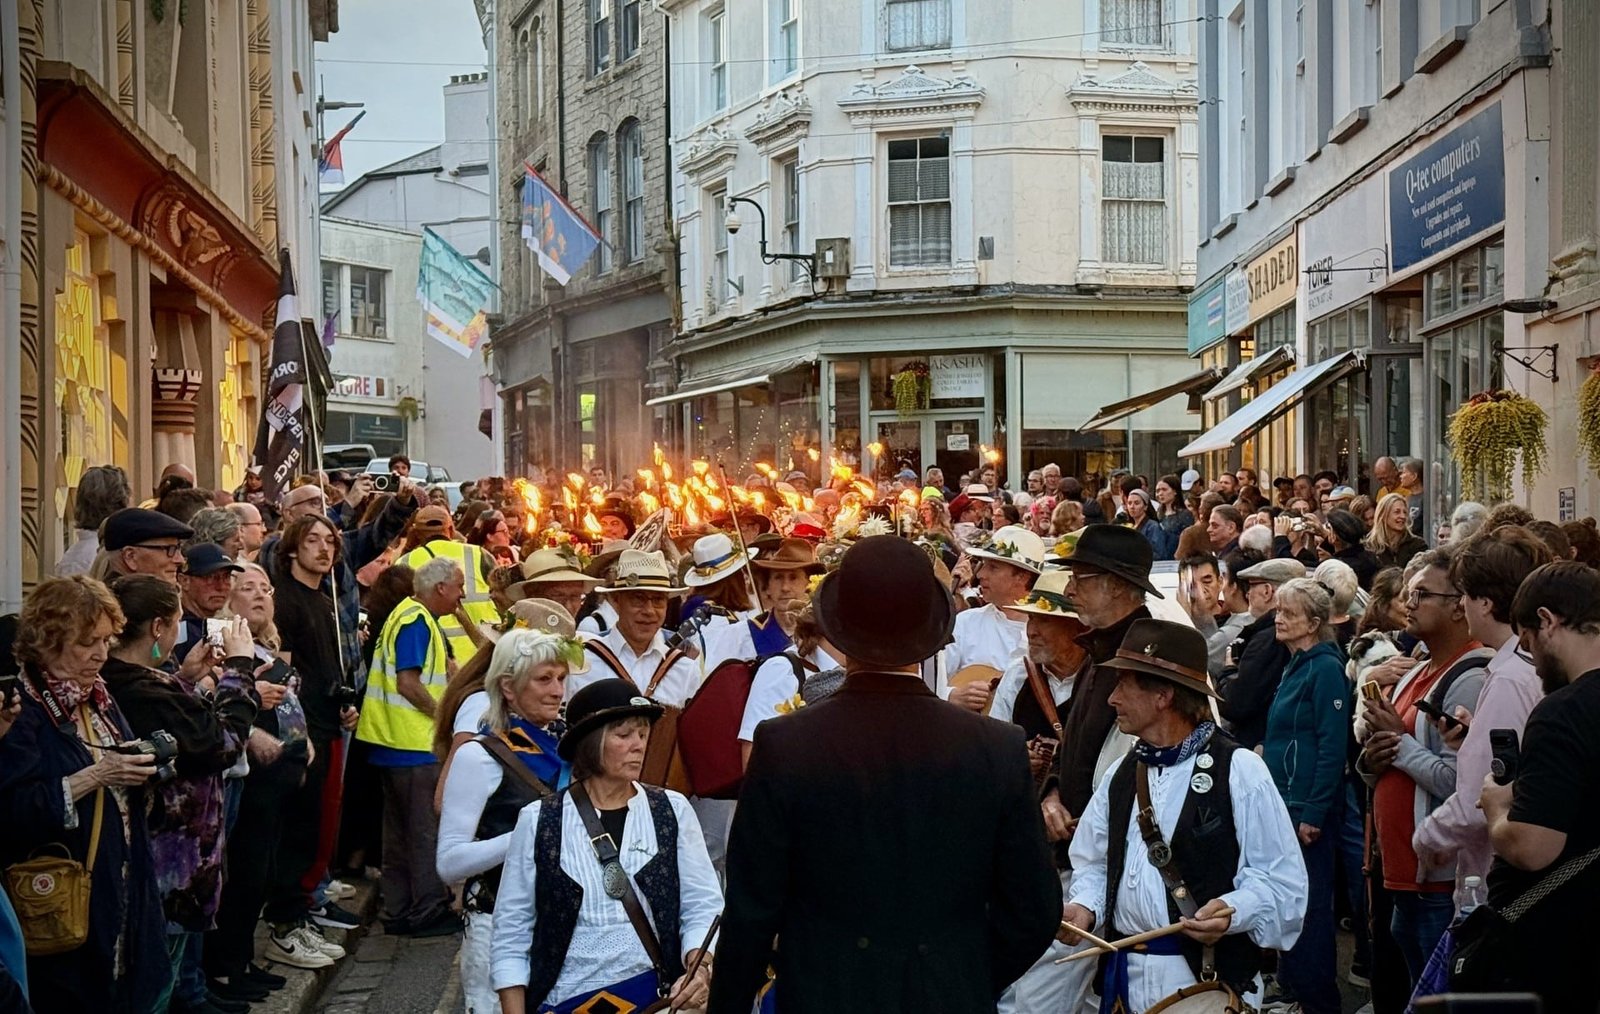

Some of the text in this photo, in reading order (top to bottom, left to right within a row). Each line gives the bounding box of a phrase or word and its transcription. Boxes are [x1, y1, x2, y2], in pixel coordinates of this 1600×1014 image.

[1406, 135, 1480, 204] Q-tec computers
[1436, 189, 1455, 206] computers
[1248, 245, 1295, 303] SHADED
[930, 356, 984, 370] AKASHA
[42, 690, 62, 717] Canon
